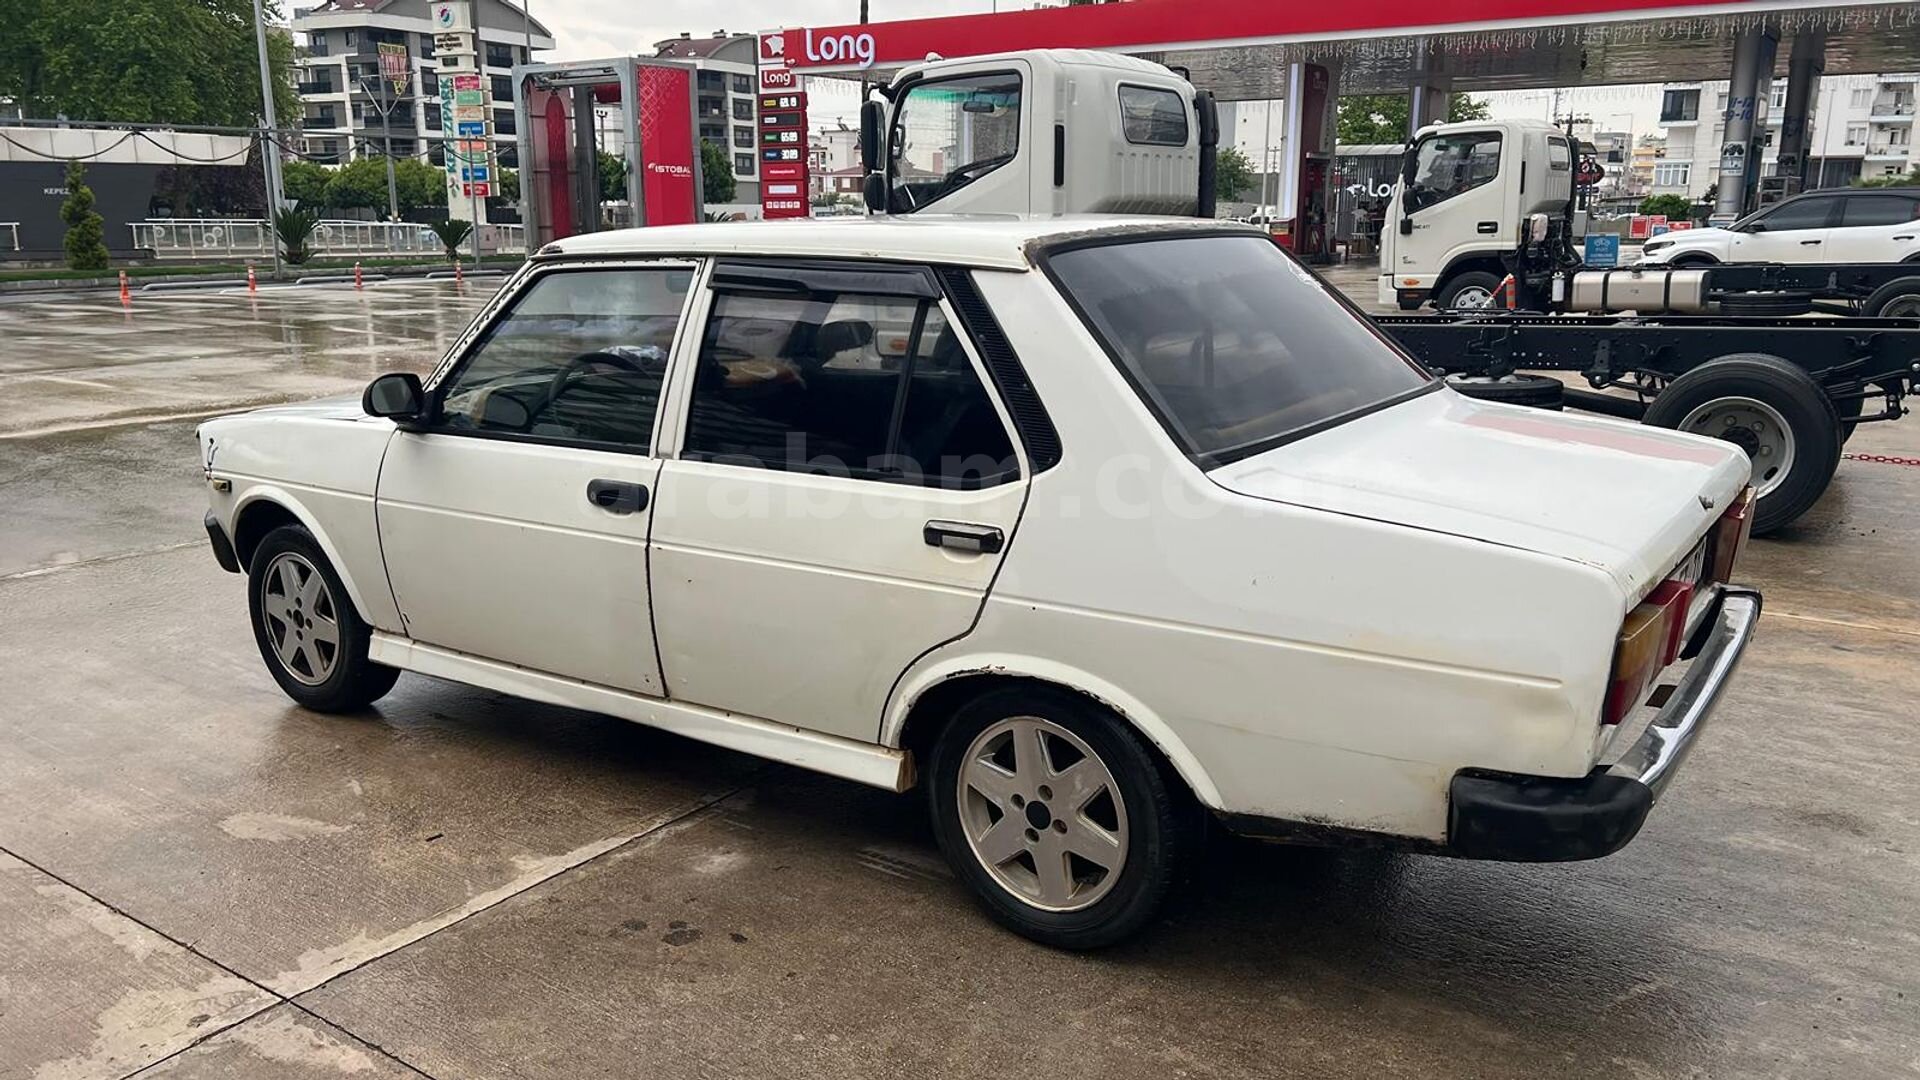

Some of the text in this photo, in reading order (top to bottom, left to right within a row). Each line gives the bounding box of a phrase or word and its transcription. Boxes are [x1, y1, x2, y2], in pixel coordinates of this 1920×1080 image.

[805, 28, 875, 69] Long
[763, 71, 791, 86] Long
[655, 165, 691, 174] ISTOBAL
[44, 187, 72, 195] KEPEZ
